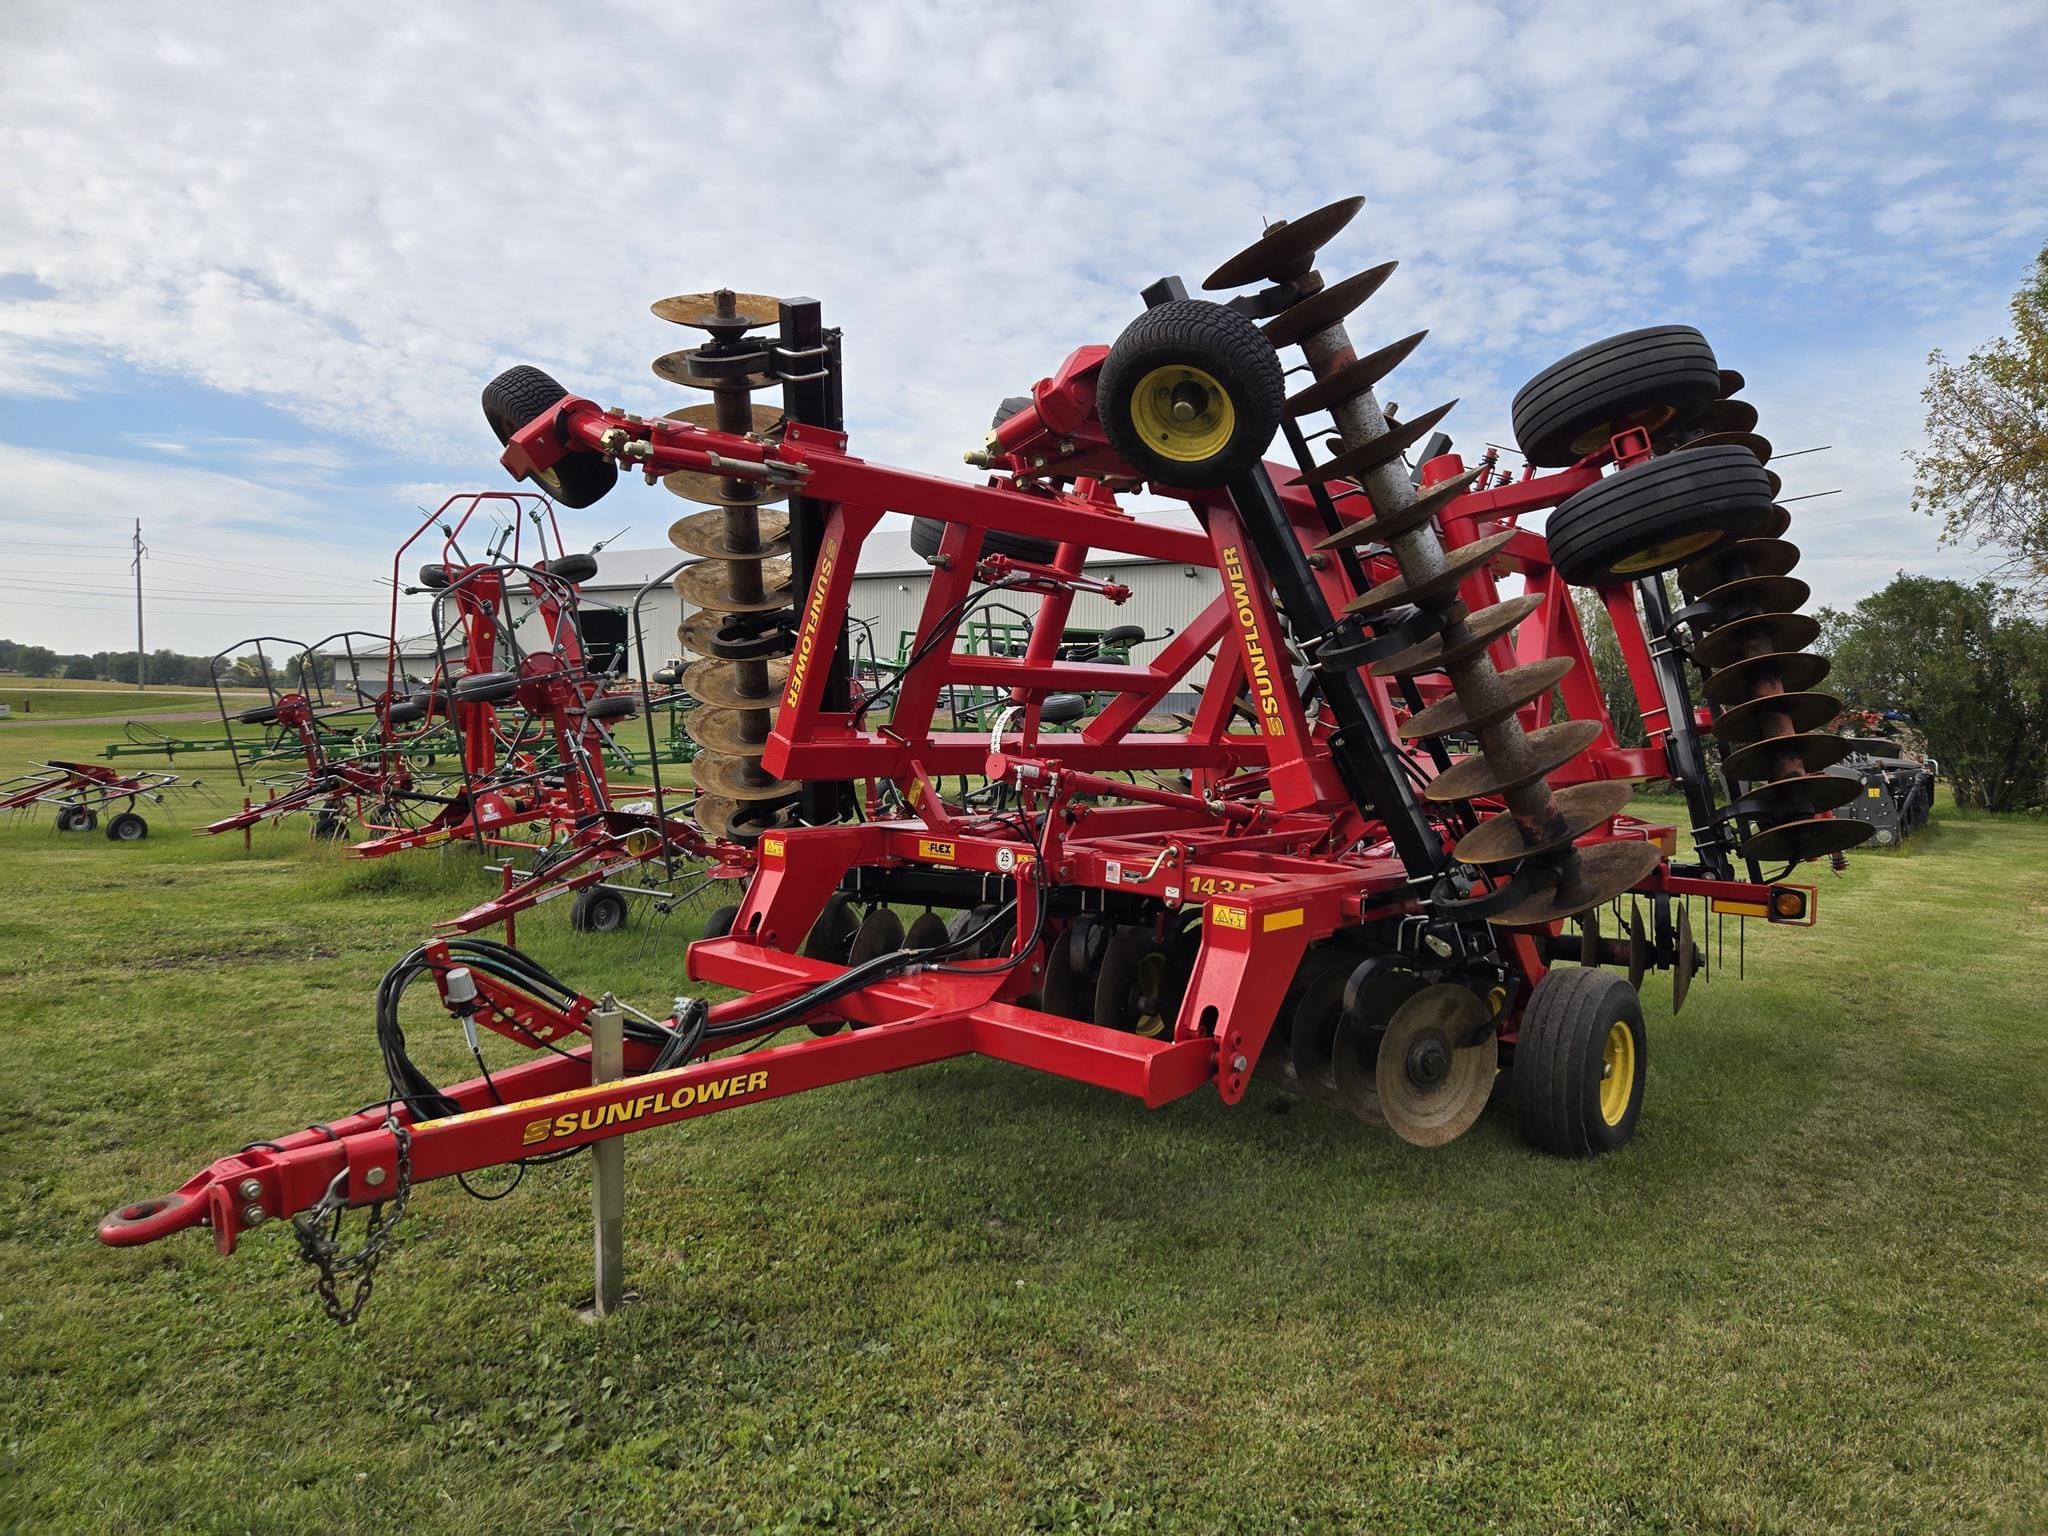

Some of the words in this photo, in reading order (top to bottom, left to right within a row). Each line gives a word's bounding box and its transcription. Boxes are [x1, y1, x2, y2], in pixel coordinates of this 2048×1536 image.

[786, 556, 833, 709] SUNFLOWER
[1223, 545, 1279, 715] SUNFLOWER
[1001, 852, 1010, 863] 25
[553, 1070, 769, 1138] SUNFLOWER
